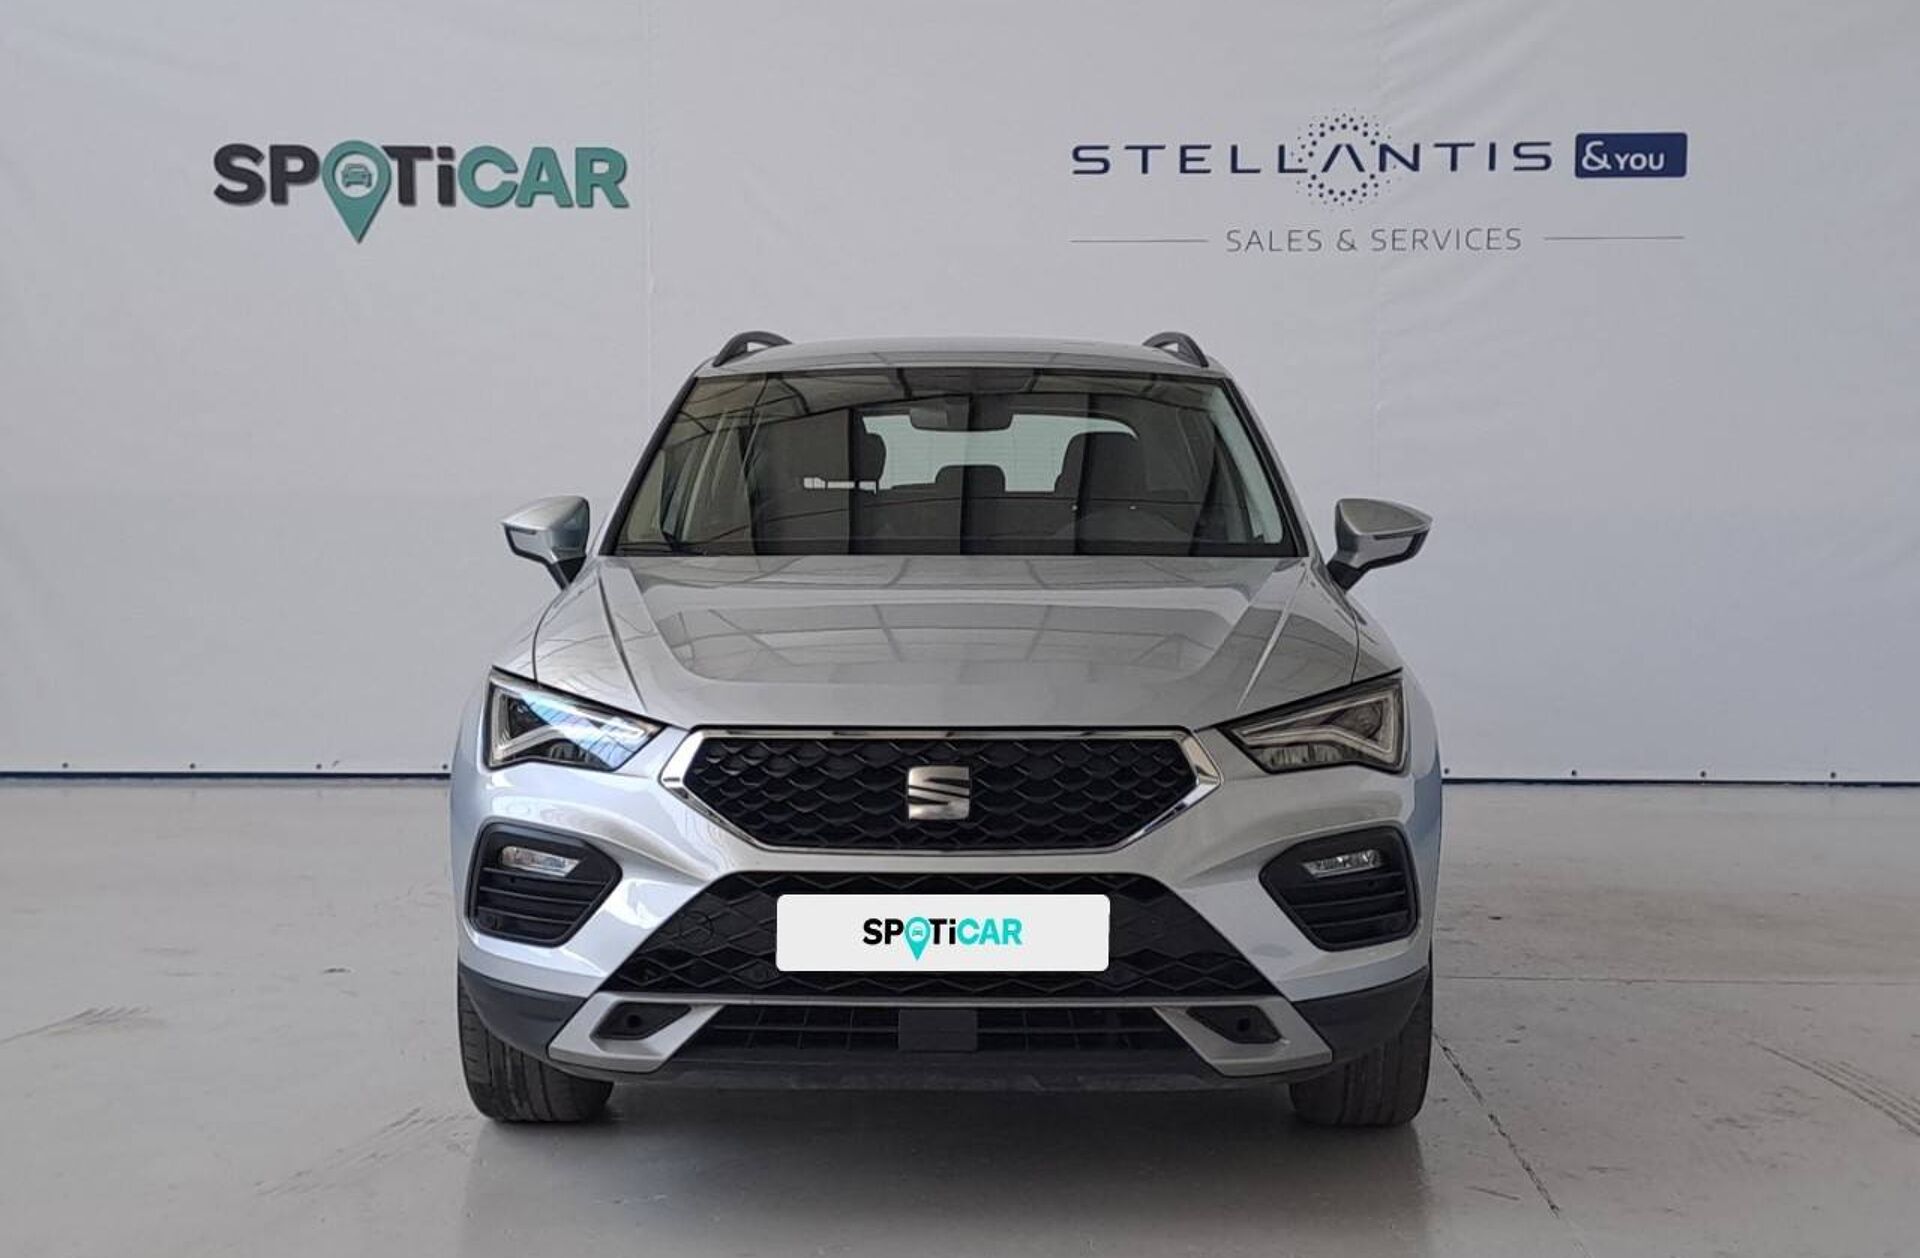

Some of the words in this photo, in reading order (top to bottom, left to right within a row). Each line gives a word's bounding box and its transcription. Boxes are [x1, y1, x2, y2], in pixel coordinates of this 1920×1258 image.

[1071, 141, 1553, 175] STELLANTIS
[1225, 229, 1323, 253] SALES
[1336, 230, 1360, 252] &
[1370, 227, 1523, 252] SERVICES
